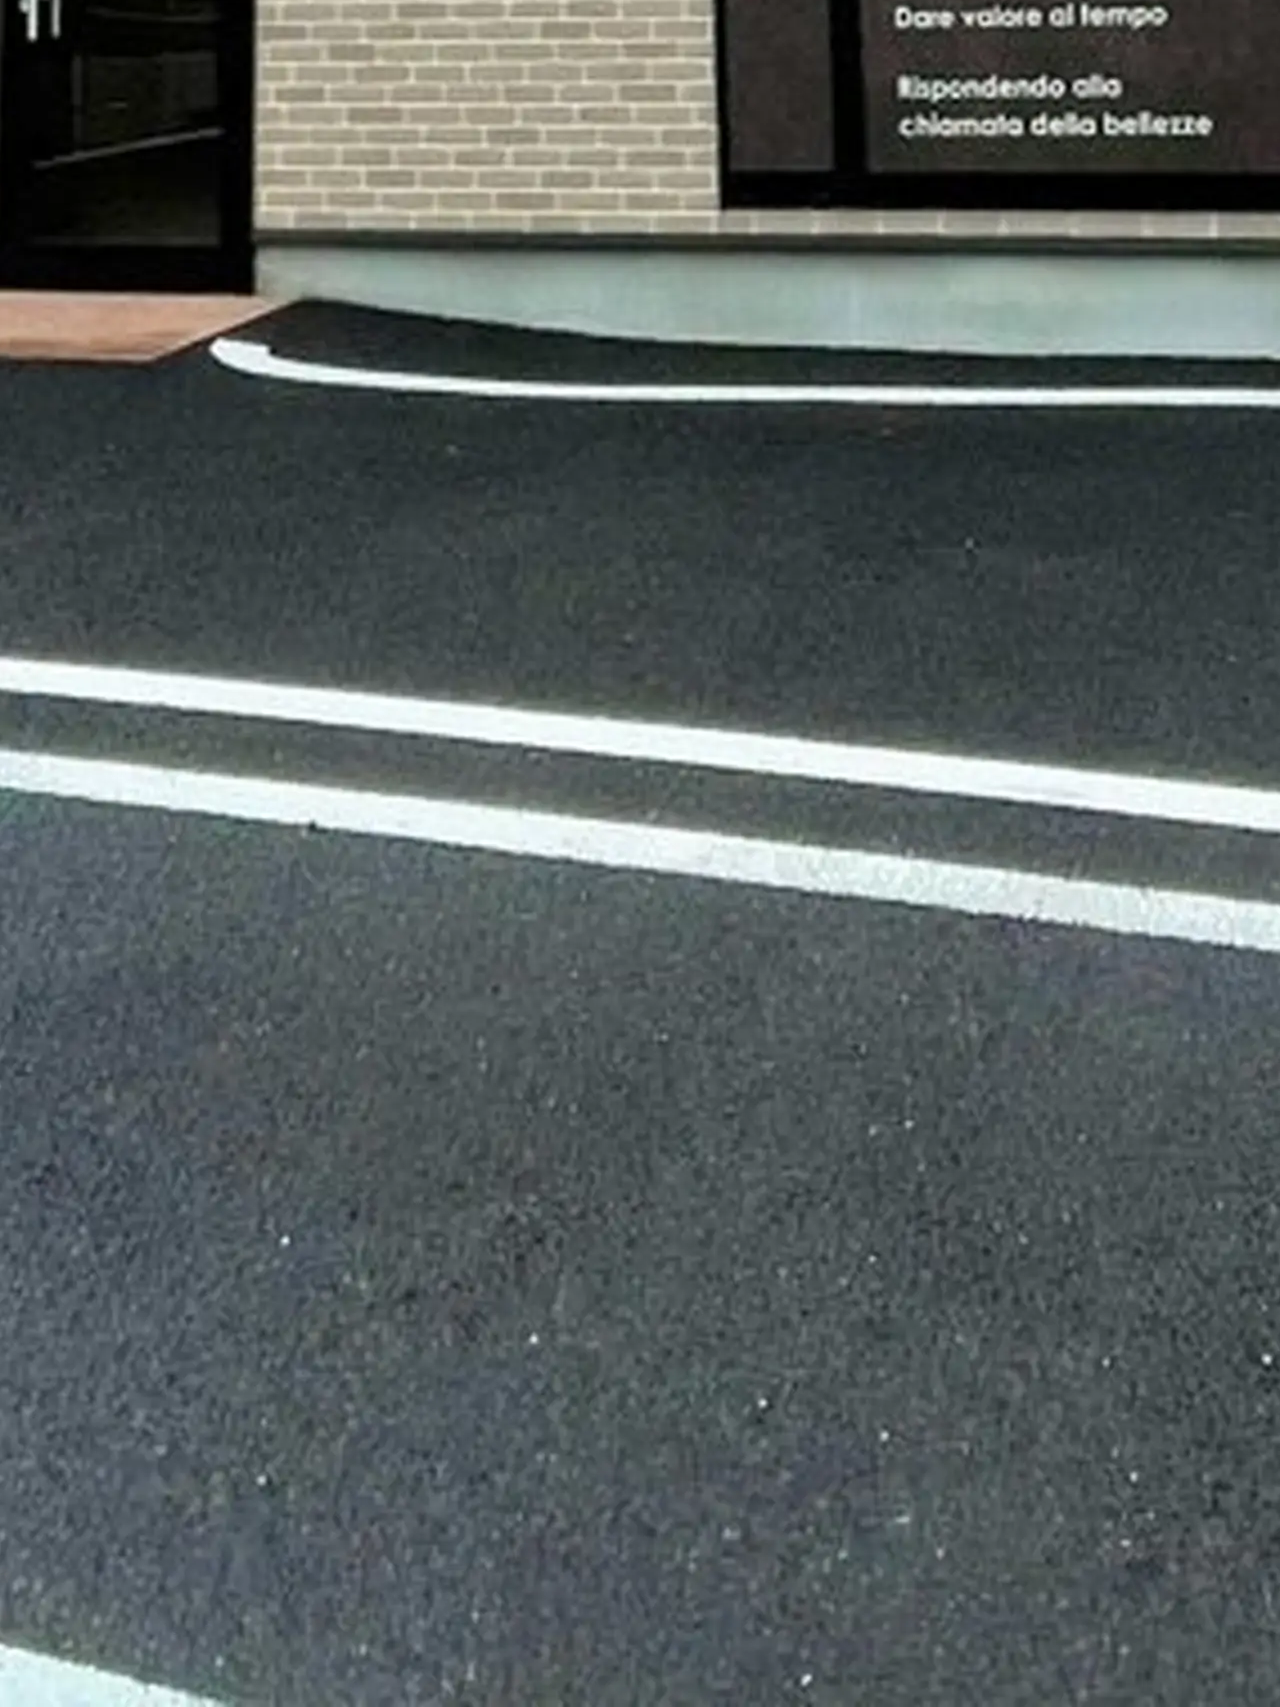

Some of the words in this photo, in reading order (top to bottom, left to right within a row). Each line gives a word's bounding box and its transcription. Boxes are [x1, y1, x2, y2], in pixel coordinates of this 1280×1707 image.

[894, 5, 955, 29] Dare
[959, 4, 1043, 28] valore
[1048, 2, 1075, 27] al
[1080, 3, 1169, 30] tempo
[897, 73, 1066, 103] Rispondendo
[1071, 73, 1123, 100] alla
[898, 112, 1024, 137] chiamata
[1029, 112, 1097, 137] della
